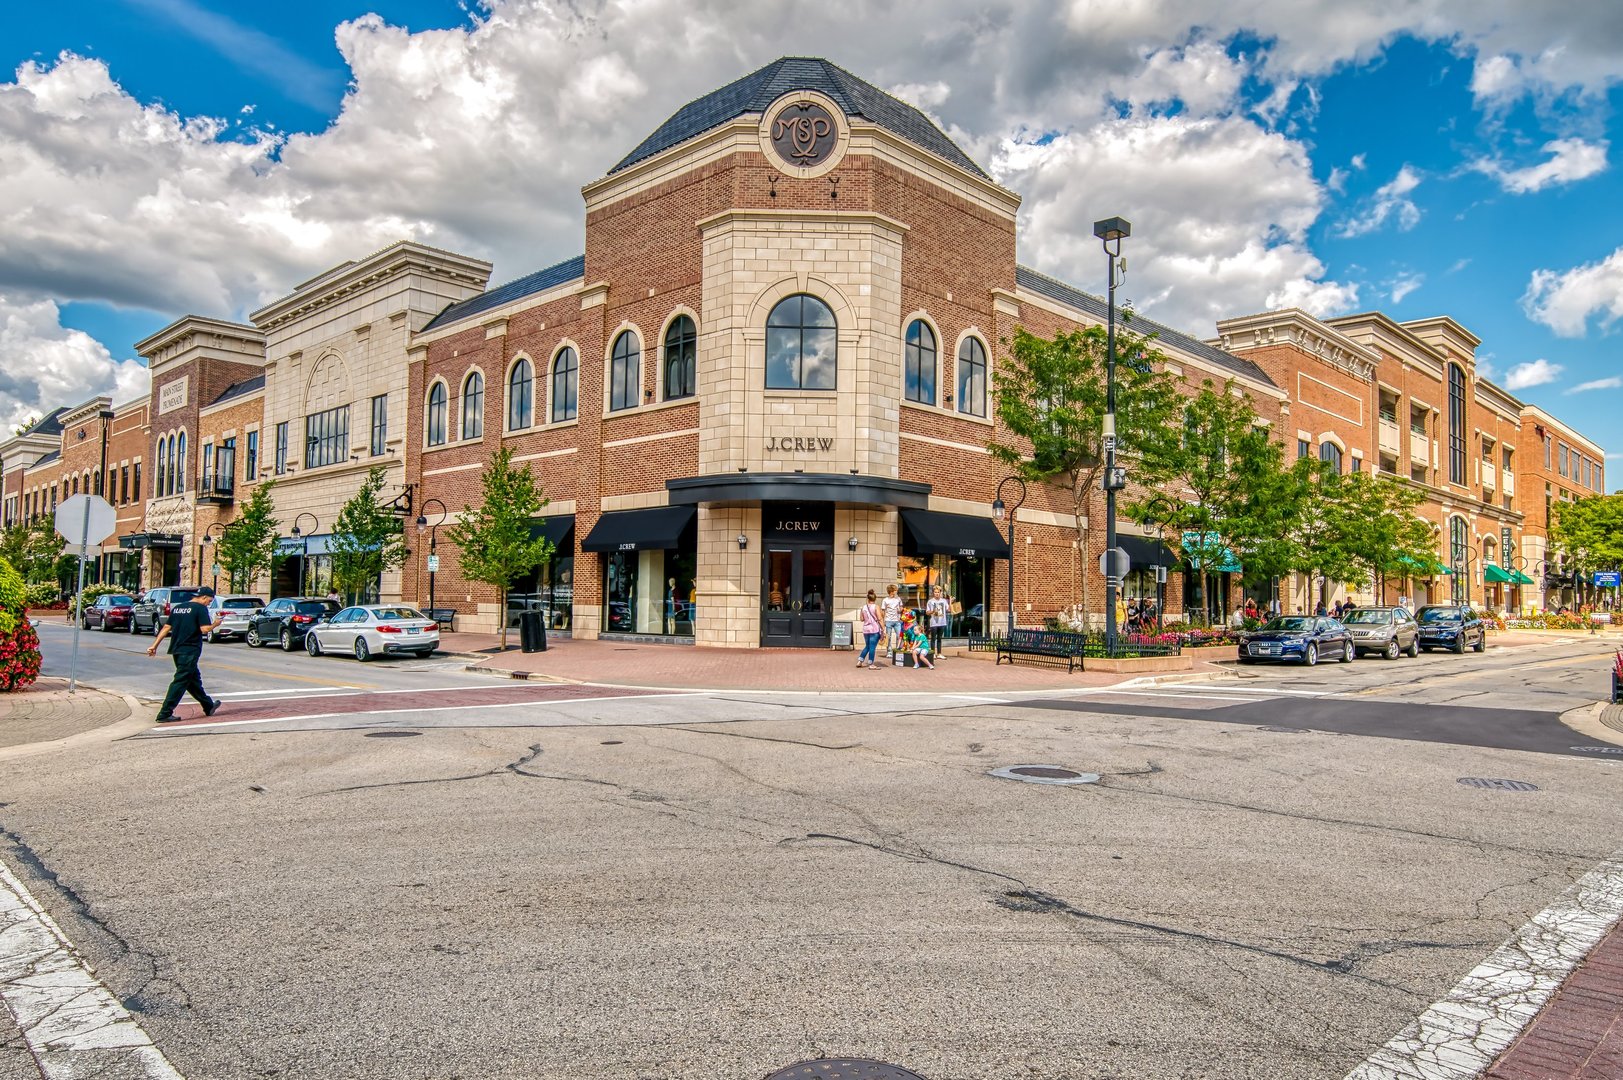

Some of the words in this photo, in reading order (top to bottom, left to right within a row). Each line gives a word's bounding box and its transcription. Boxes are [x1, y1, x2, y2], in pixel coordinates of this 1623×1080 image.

[163, 387, 171, 397] MAIN
[171, 382, 184, 394] STREET
[163, 394, 183, 410] PROMENADE
[766, 437, 833, 452] J.CREW
[775, 521, 820, 531] J.CREW
